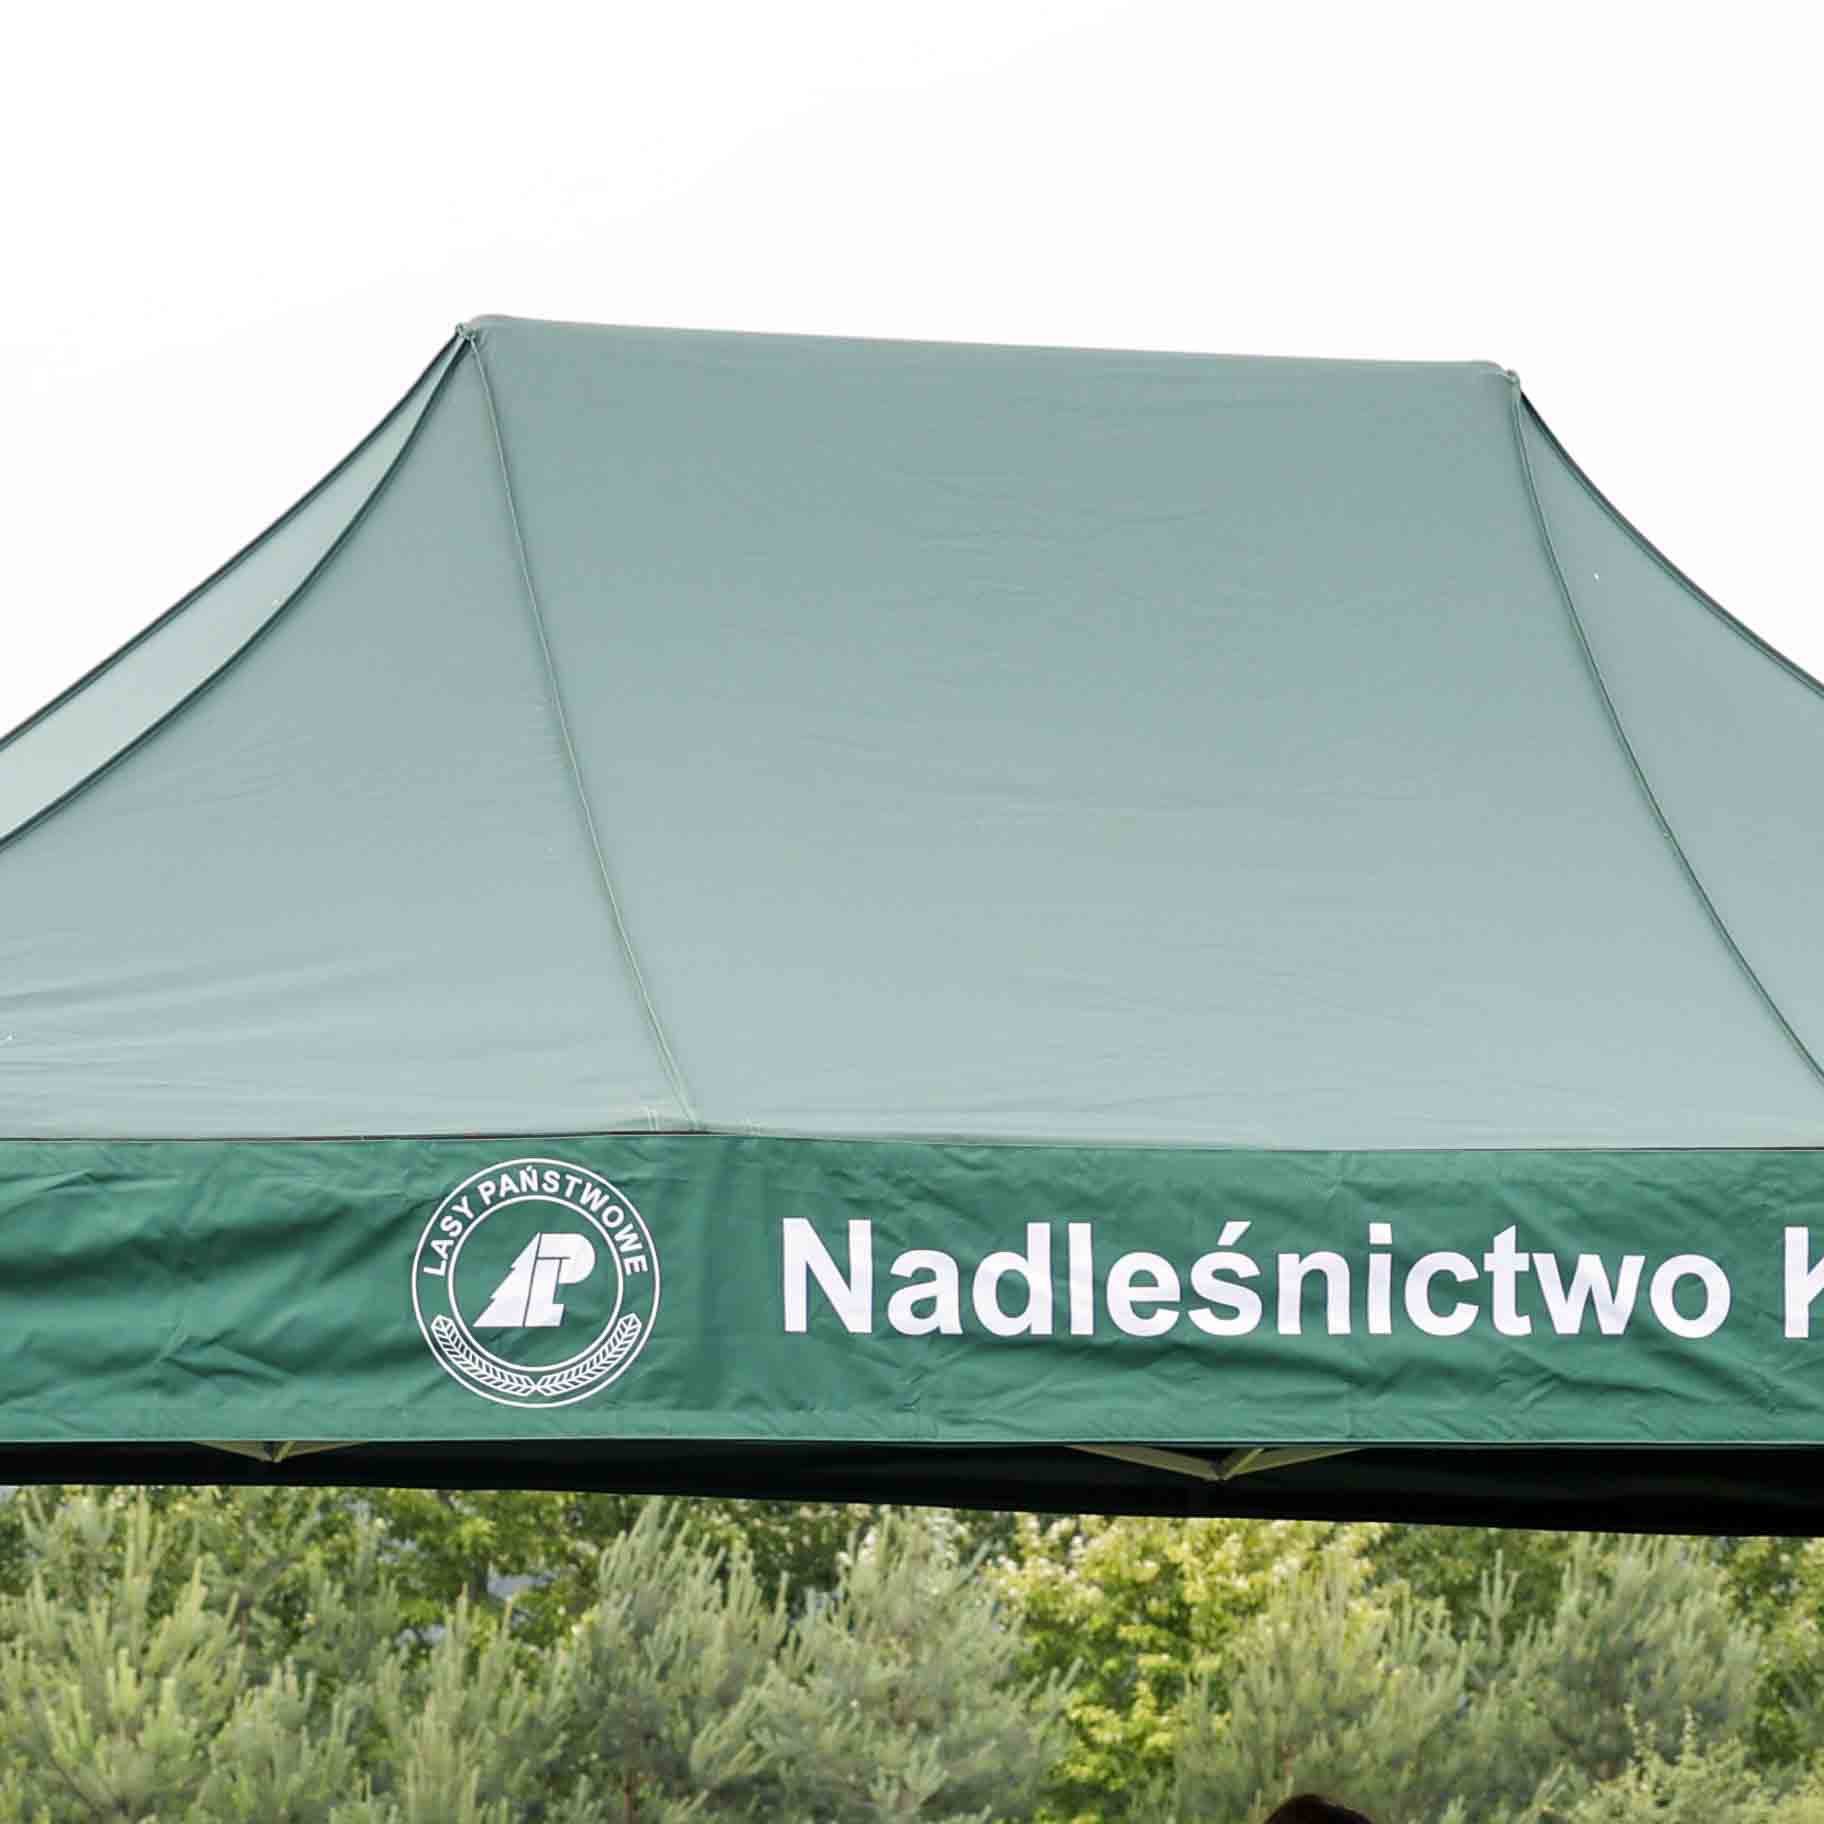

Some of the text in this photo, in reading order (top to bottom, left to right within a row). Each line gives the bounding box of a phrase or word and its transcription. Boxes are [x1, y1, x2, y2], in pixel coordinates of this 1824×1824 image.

[423, 1165, 648, 1277] LASY PAŃSTWOWE
[779, 1218, 1731, 1340] Nadleśnictwo
